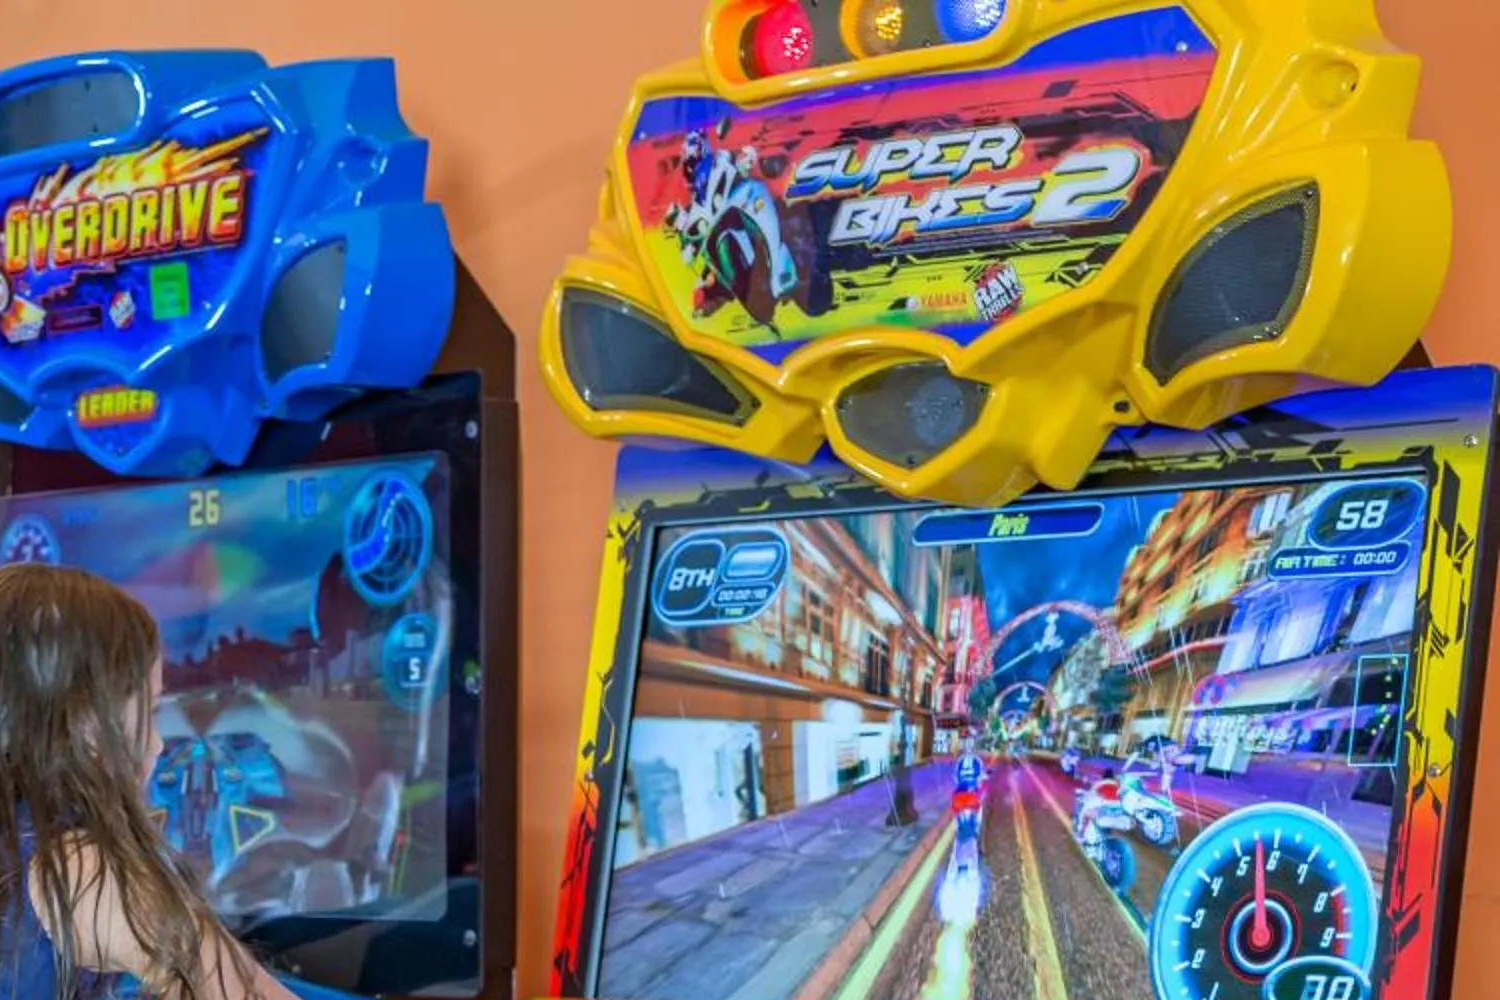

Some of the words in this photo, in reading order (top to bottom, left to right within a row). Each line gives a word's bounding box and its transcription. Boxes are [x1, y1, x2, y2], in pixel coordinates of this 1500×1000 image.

[786, 126, 1022, 198] SUPER
[830, 179, 1044, 244] BIKES
[1032, 149, 1140, 226] 2
[974, 267, 1024, 309] RAW
[77, 389, 157, 420] LEADER
[188, 489, 221, 528] 26
[1335, 498, 1389, 531] 58
[1353, 550, 1398, 566] 00:00
[668, 567, 716, 591] 8TH
[1236, 856, 1250, 876] 5
[1266, 851, 1281, 872] 6
[1210, 876, 1224, 897] 4
[1191, 908, 1206, 929] 3
